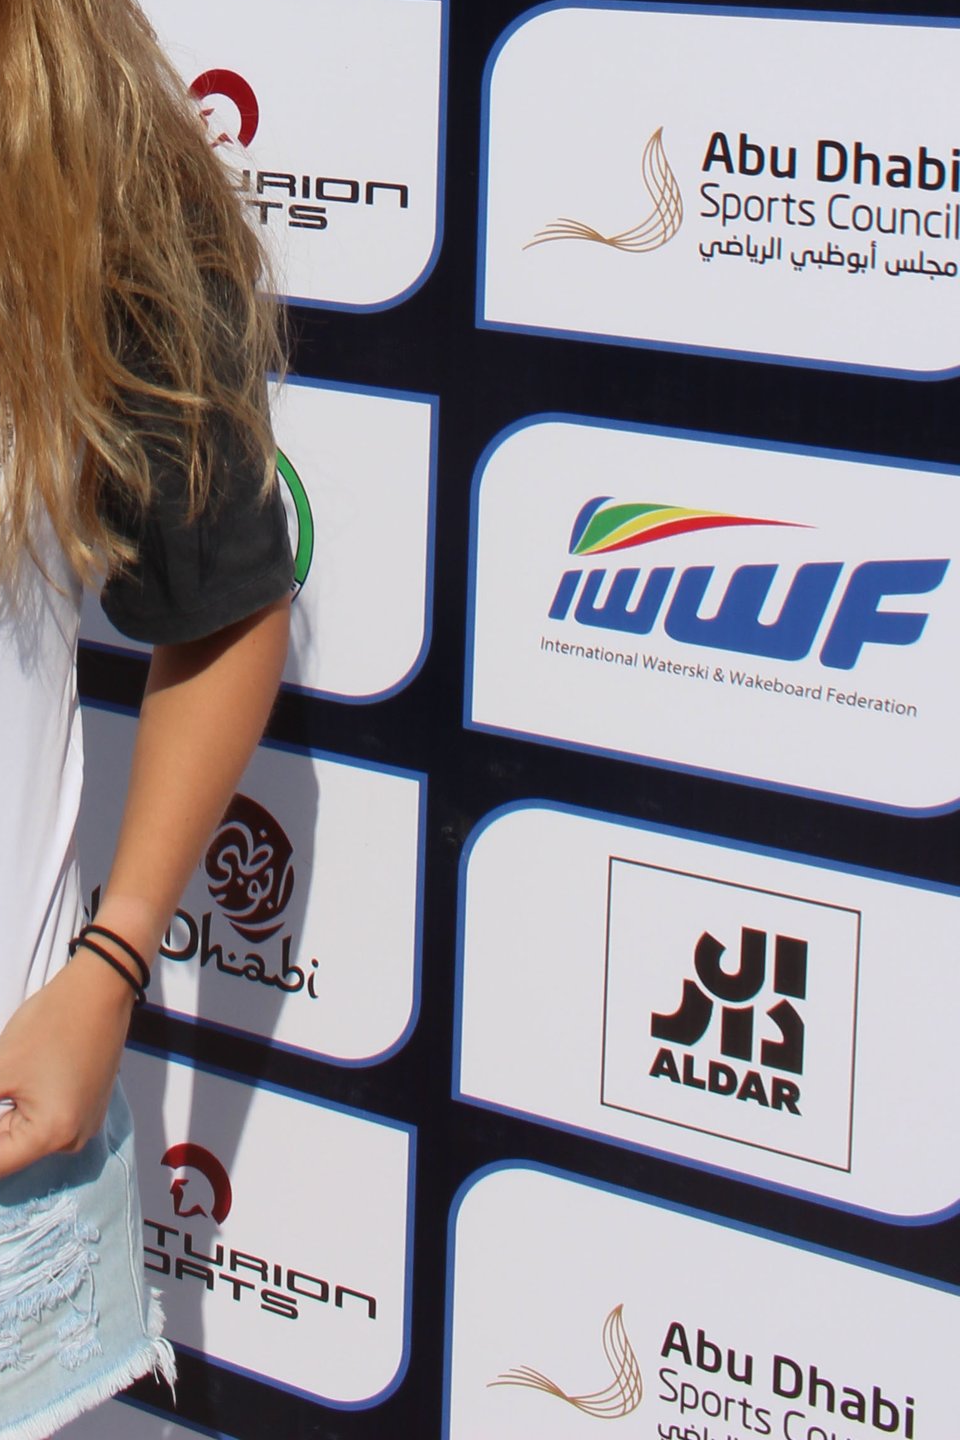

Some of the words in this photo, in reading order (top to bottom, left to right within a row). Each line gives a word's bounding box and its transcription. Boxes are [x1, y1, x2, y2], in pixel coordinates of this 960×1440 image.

[702, 132, 797, 179] Abu
[817, 140, 960, 192] Dhabi
[700, 183, 815, 227] Sports
[828, 194, 960, 240] Council
[699, 235, 782, 264] الرياضي
[885, 251, 958, 280] مجلس
[541, 636, 638, 667] International
[643, 654, 709, 680] Waterski
[713, 668, 724, 683] &
[730, 670, 822, 700] Wakeboard
[826, 687, 917, 717] Federation
[649, 1048, 801, 1116] ALDAR
[659, 1368, 771, 1435] Sports
[661, 1322, 753, 1385] Abu
[773, 1355, 914, 1440] Dhabi
